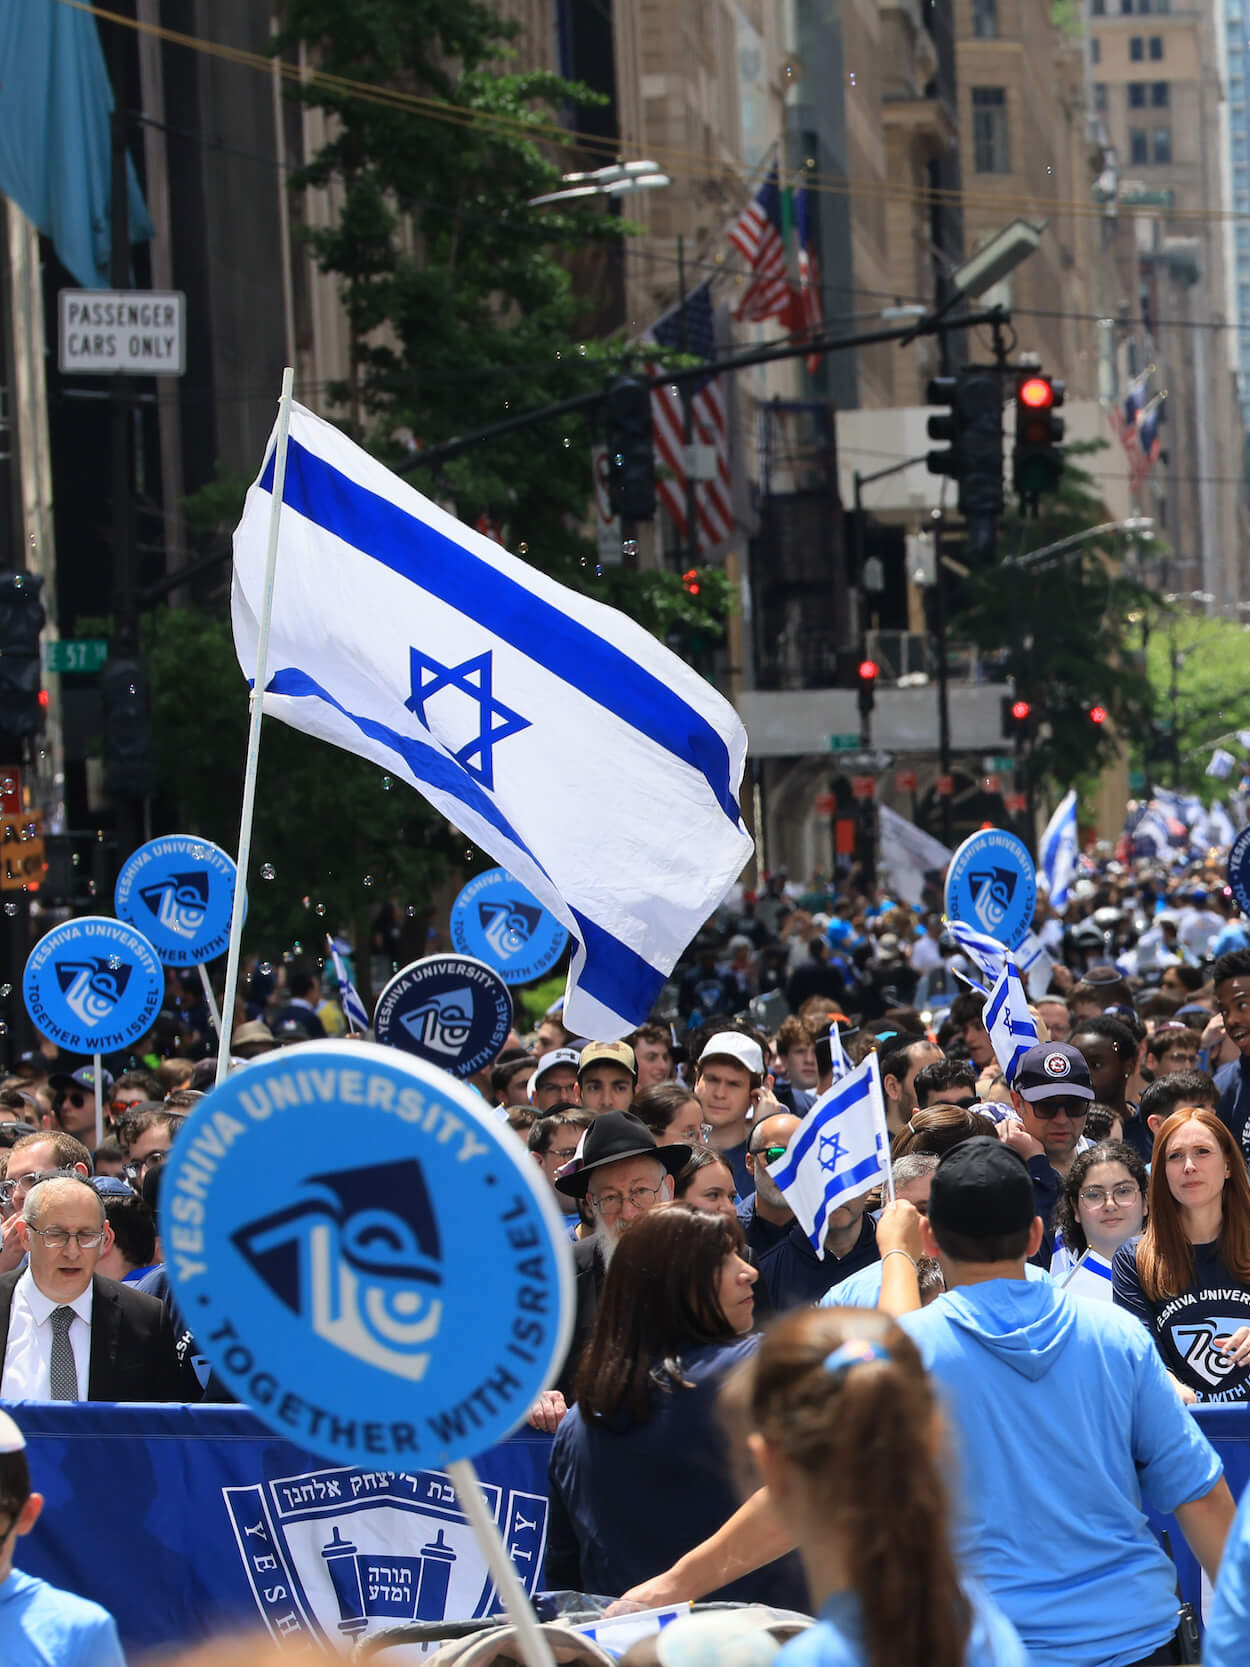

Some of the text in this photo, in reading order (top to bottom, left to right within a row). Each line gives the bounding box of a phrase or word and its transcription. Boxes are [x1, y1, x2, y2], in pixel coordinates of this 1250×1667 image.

[68, 302, 176, 328] PASSENGER
[68, 333, 175, 358] CARS ONLY
[118, 851, 152, 904] YESHIVA
[30, 924, 158, 975] YESHIVA UNIVERSITY
[191, 935, 225, 960] WITH
[28, 984, 159, 1049] TOGETHER WITH ISRAEL
[378, 963, 496, 1035] YESHIVA UNIVERSITY
[457, 994, 509, 1075] WITH ISRAEL
[170, 1066, 491, 1284] YESHIVA UNIVERSITY
[208, 1193, 552, 1454] TOGETHER WITH ISRAEL
[1208, 1384, 1246, 1402] WITH
[368, 1567, 412, 1584] תורה
[368, 1585, 411, 1602] ומדע
